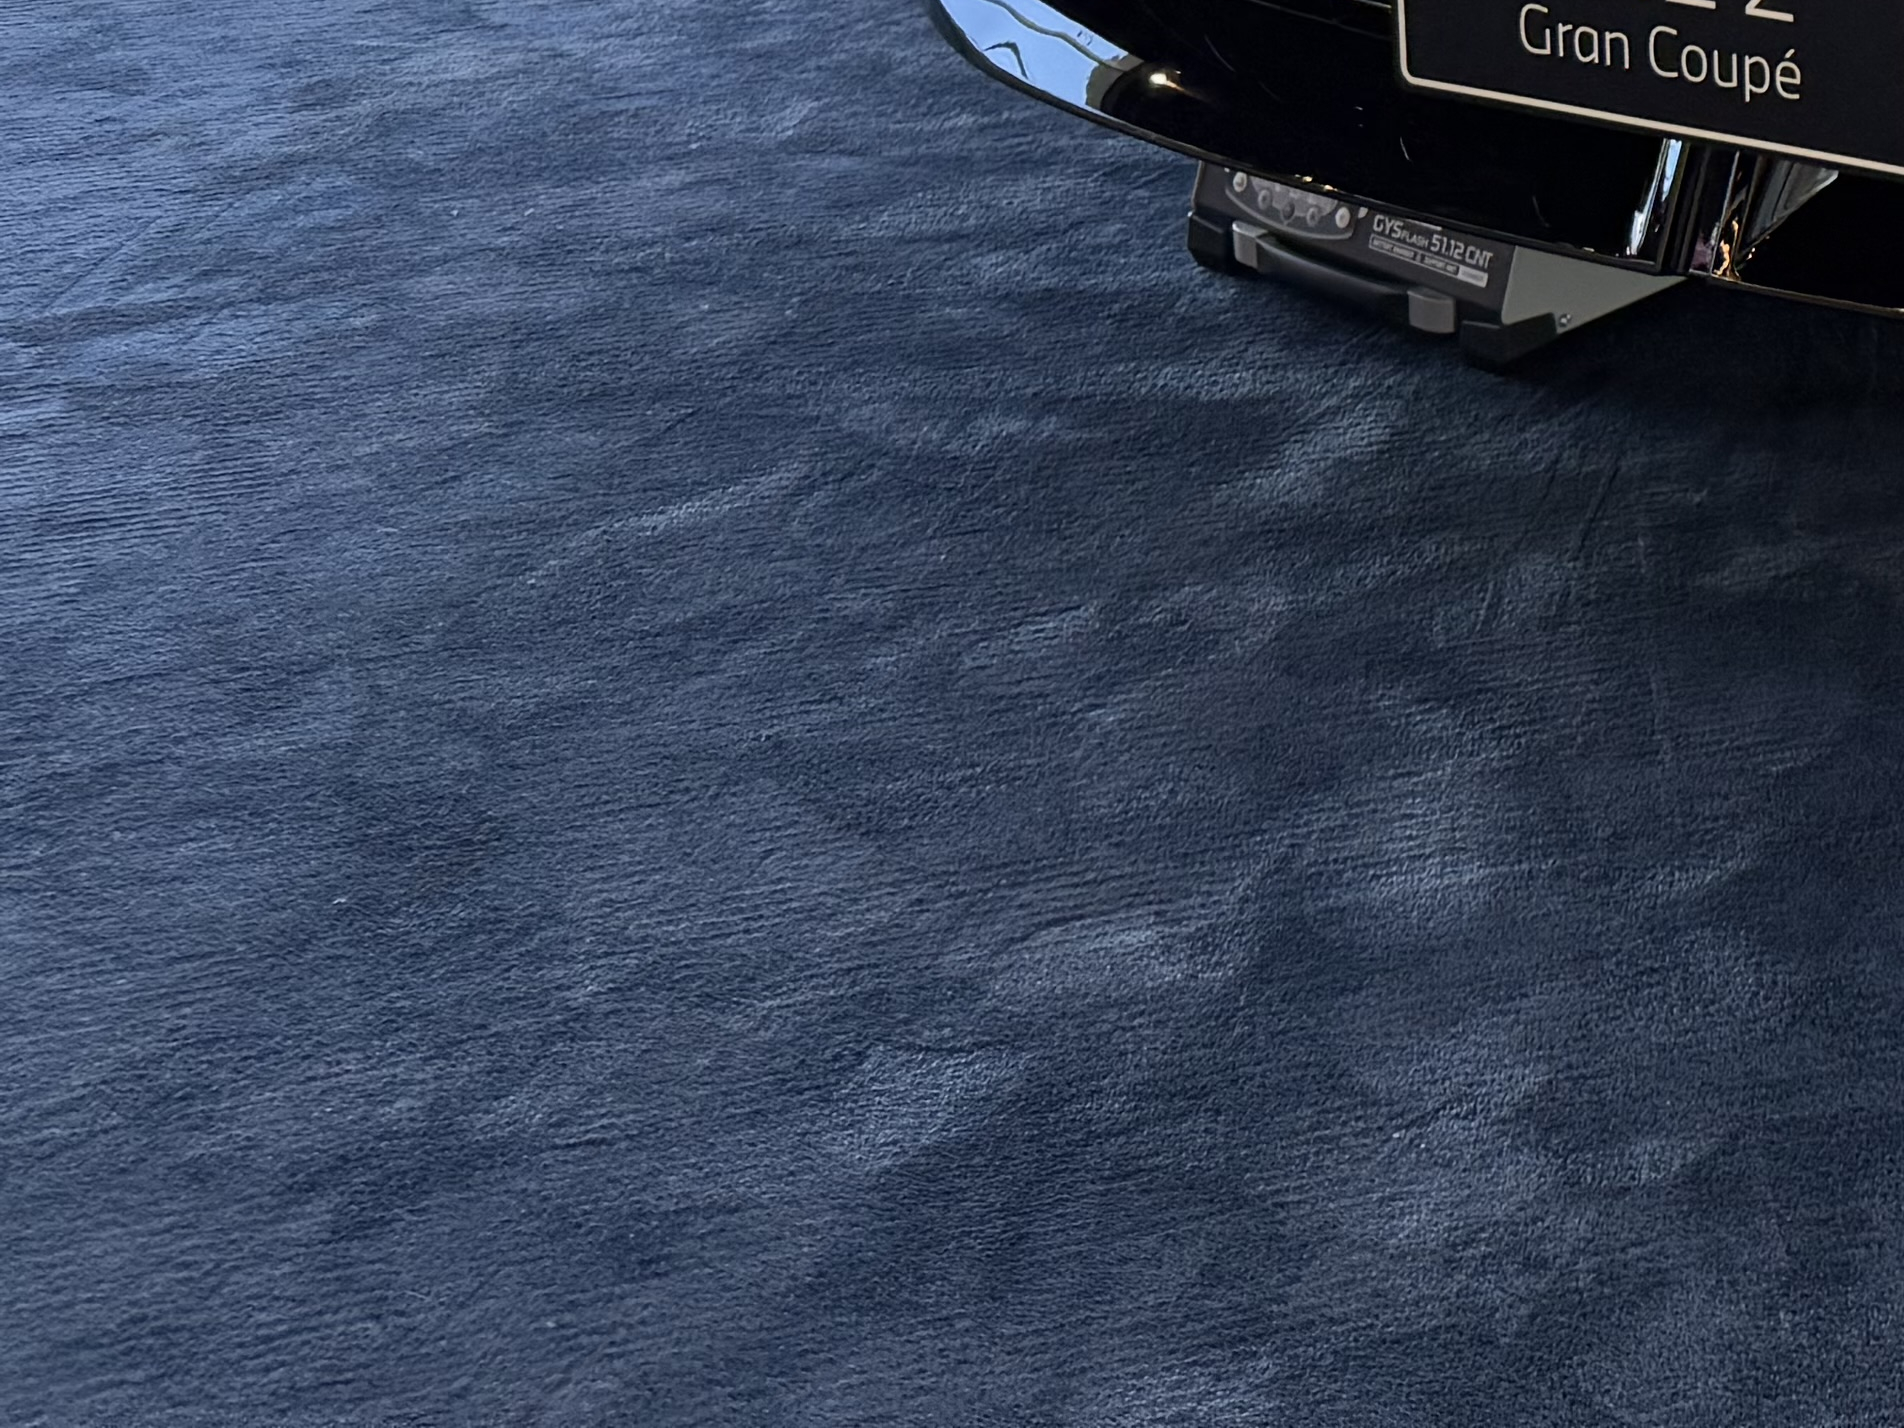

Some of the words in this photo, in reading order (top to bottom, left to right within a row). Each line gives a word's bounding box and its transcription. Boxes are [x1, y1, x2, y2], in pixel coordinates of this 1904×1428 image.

[1519, 3, 1630, 70] Gran
[1648, 25, 1801, 103] Coupé
[1430, 234, 1463, 259] 51.12
[1464, 245, 1494, 269] CNT
